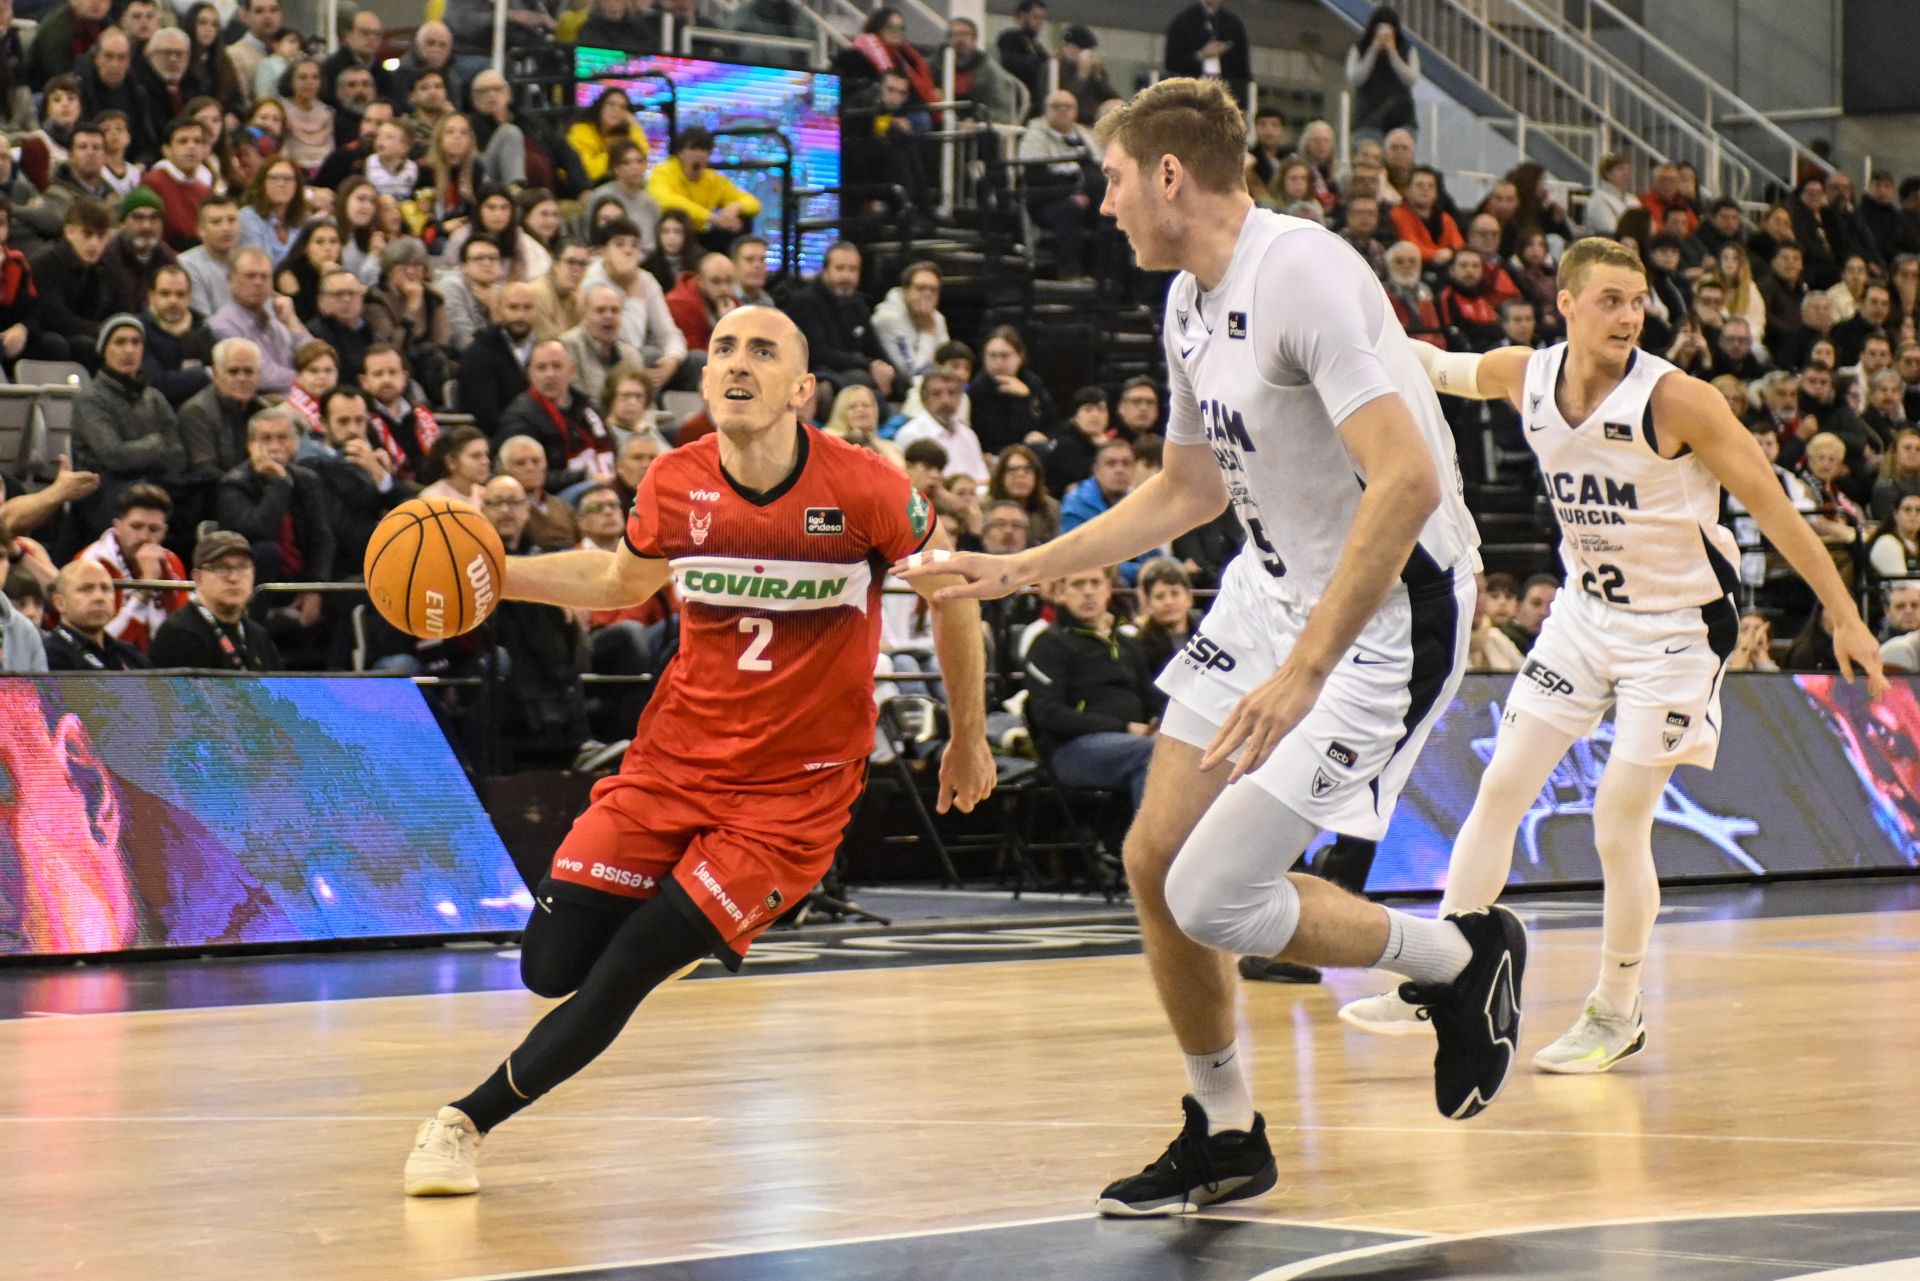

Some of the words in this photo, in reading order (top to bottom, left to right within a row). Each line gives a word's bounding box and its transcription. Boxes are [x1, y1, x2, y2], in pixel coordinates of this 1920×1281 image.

[1199, 400, 1256, 452] CAM
[690, 489, 720, 502] vive
[808, 515, 824, 525] liga
[808, 524, 842, 532] endesa
[685, 565, 848, 599] COVIRAN
[1582, 564, 1631, 604] 22
[738, 617, 773, 671] 2
[1523, 660, 1574, 695] ESP
[1330, 748, 1349, 764] acb
[556, 857, 584, 872] vive
